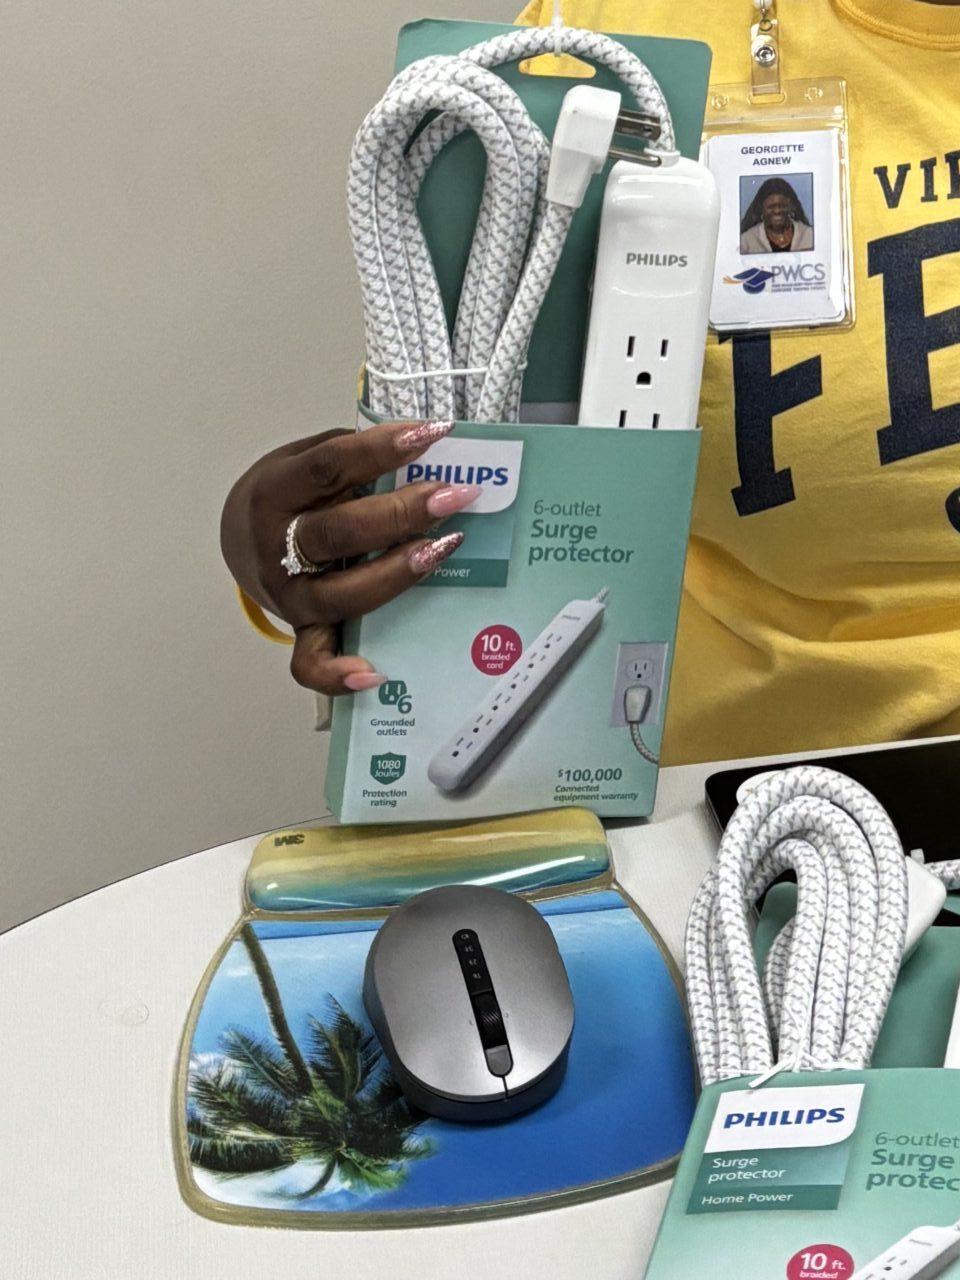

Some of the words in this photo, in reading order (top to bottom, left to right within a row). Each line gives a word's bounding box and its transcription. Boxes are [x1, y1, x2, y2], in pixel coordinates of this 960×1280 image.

[741, 144, 804, 154] GEORGETTE
[753, 157, 791, 165] AGNEW
[626, 253, 687, 267] PHILIPS
[771, 263, 825, 283] PWCS
[406, 462, 508, 488] PHILIPS
[534, 500, 601, 516] 6-outlet
[531, 519, 597, 542] Surge
[529, 540, 634, 565] protector
[432, 565, 470, 577] Power
[482, 635, 501, 654] 10
[506, 641, 516, 651] ft.
[482, 651, 510, 663] braided
[487, 661, 503, 669] cord
[397, 694, 413, 714] 6
[371, 718, 415, 729] Grounded
[377, 728, 407, 736] outlets
[376, 759, 401, 771] 1080
[373, 768, 402, 780] Joules
[559, 768, 622, 783] $100,000
[363, 789, 407, 800] Protection
[555, 785, 599, 794] Connected
[554, 791, 599, 802] equipment
[371, 799, 397, 807] rating
[724, 1108, 845, 1128] PHILIPS
[875, 1132, 960, 1150] 6-outlet
[713, 1158, 759, 1169] Surge
[871, 1146, 957, 1172] Surge
[708, 1166, 786, 1184] protector
[701, 1193, 744, 1205] Home
[748, 1194, 793, 1202] Power
[801, 1253, 827, 1272] 10
[832, 1260, 845, 1269] ft.
[800, 1269, 838, 1278] braided
